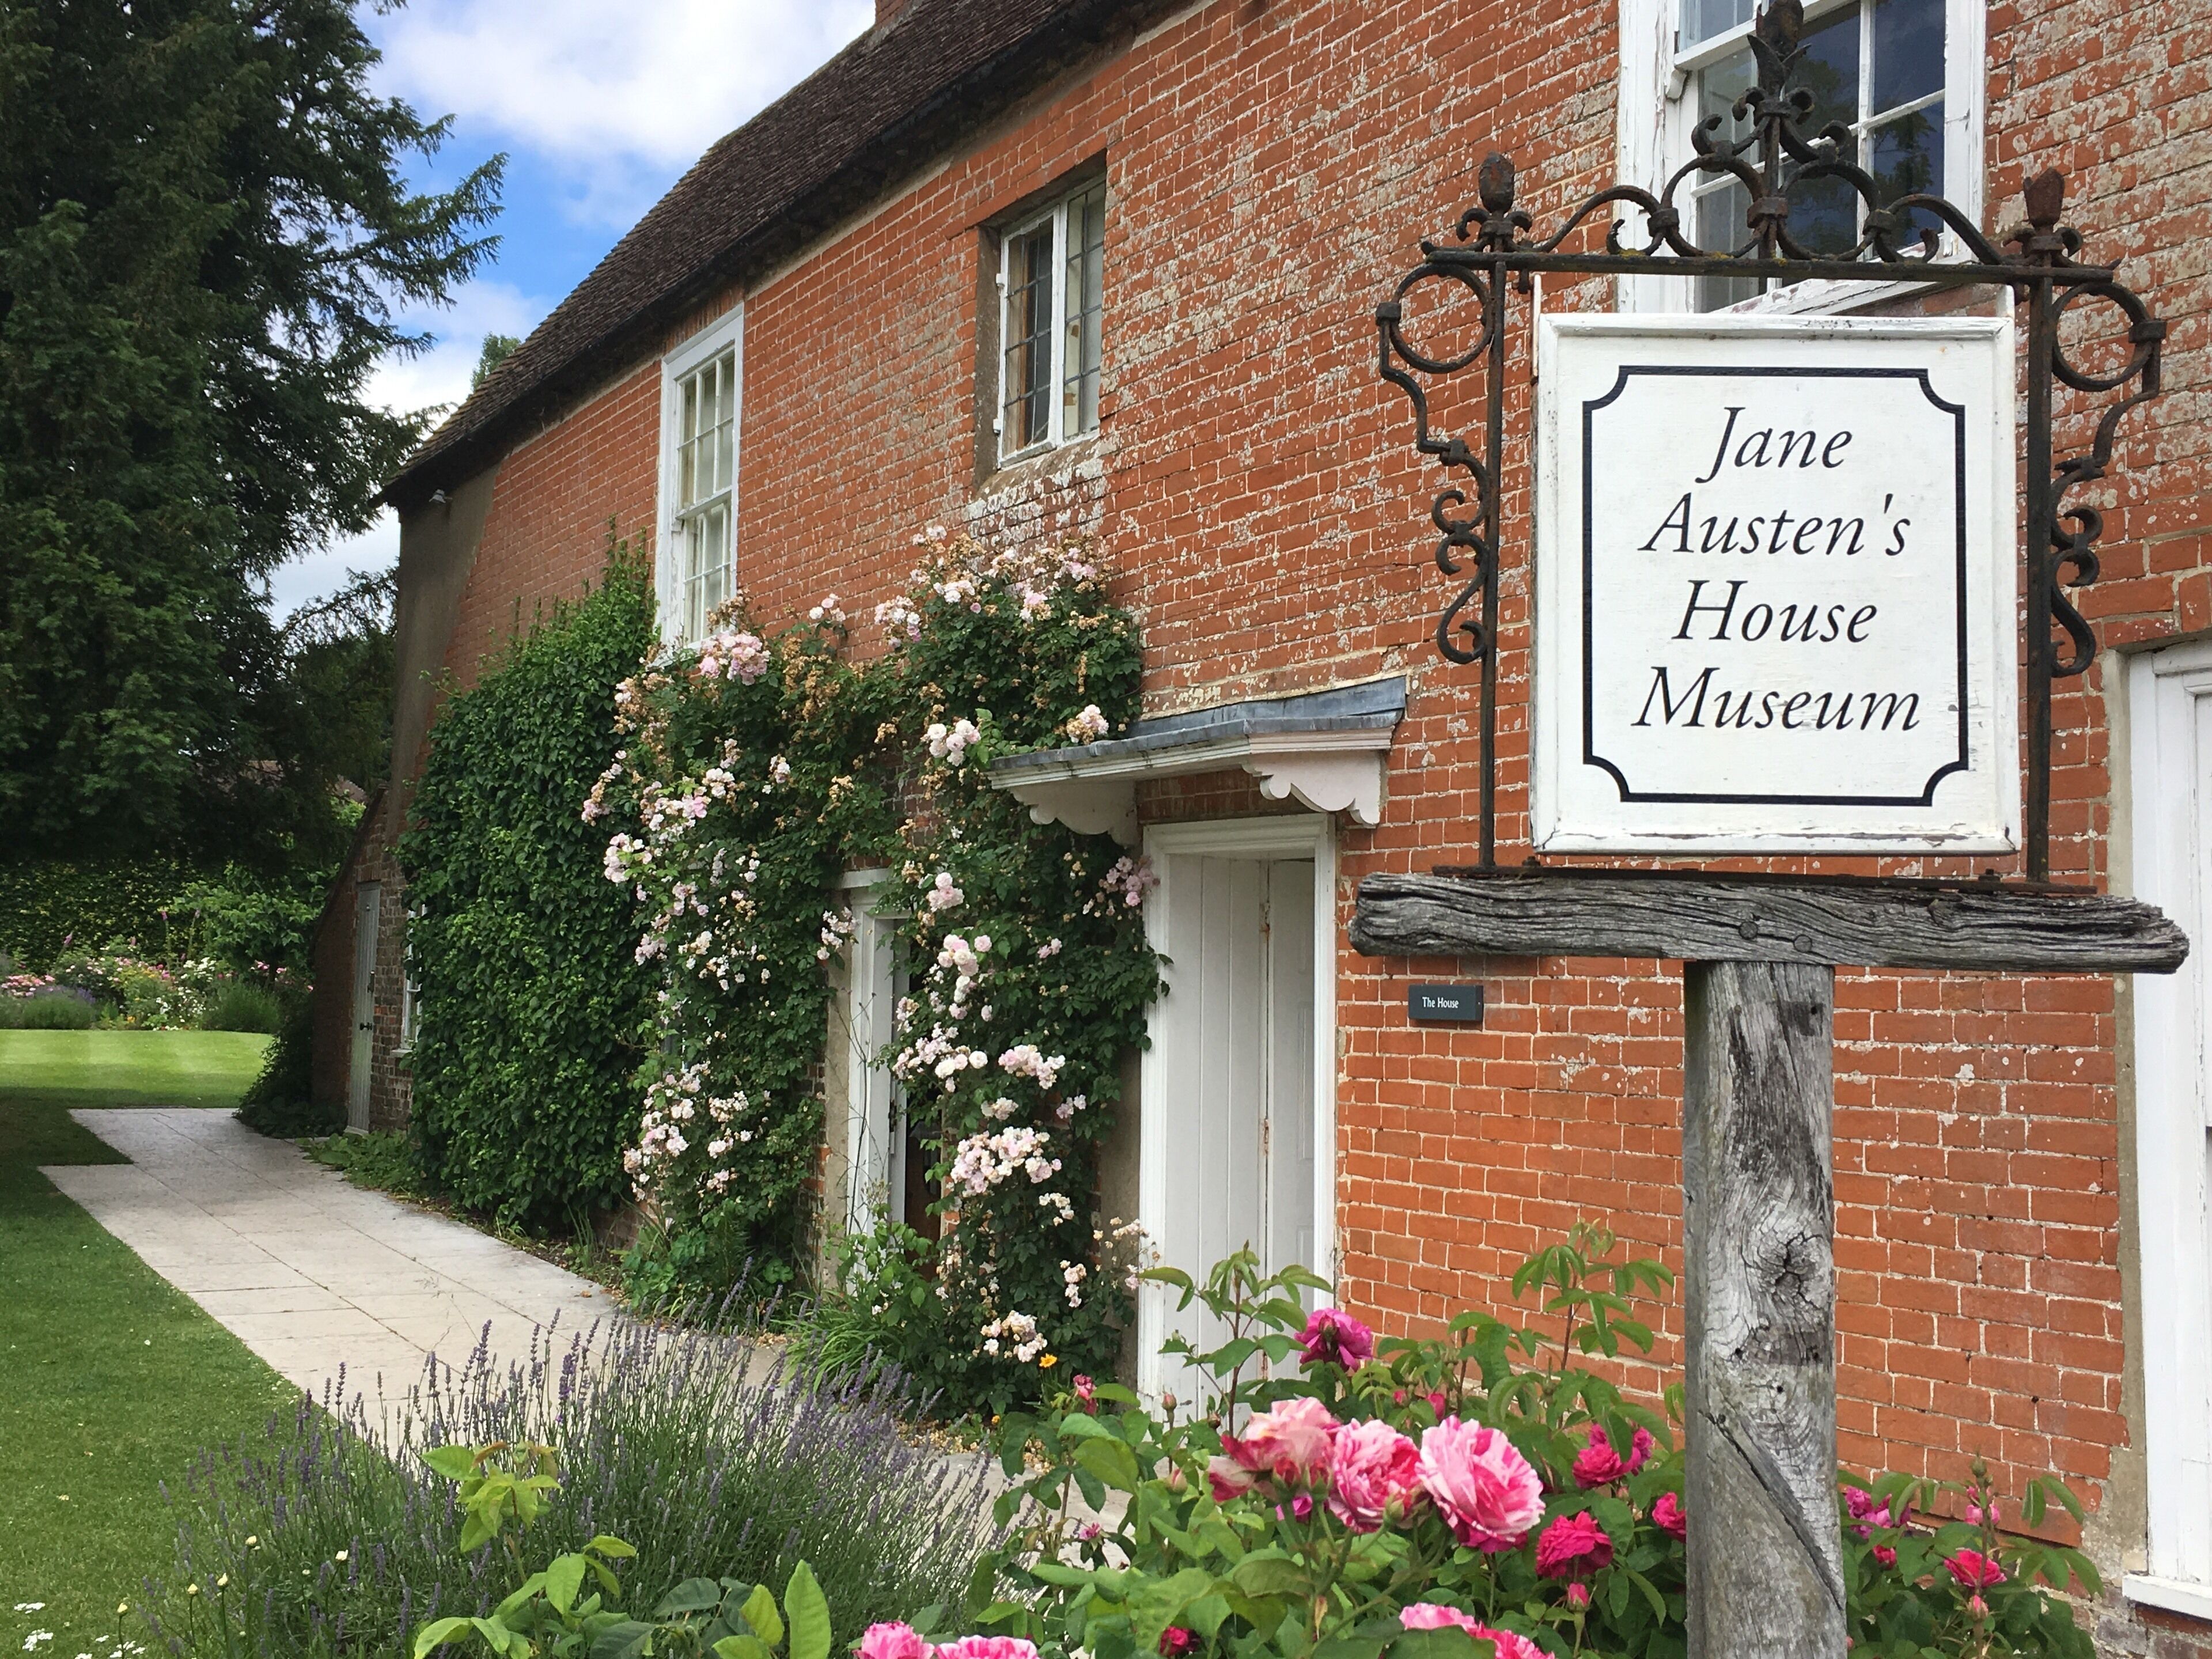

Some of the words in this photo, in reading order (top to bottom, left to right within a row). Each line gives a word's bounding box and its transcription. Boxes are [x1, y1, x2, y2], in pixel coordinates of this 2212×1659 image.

[1695, 406, 1853, 484] Jane
[1638, 492, 1911, 556] Austen's
[1671, 579, 1878, 643] House
[1631, 666, 1920, 732] Museum
[1422, 997, 1435, 1007] The
[1437, 997, 1459, 1008] House
